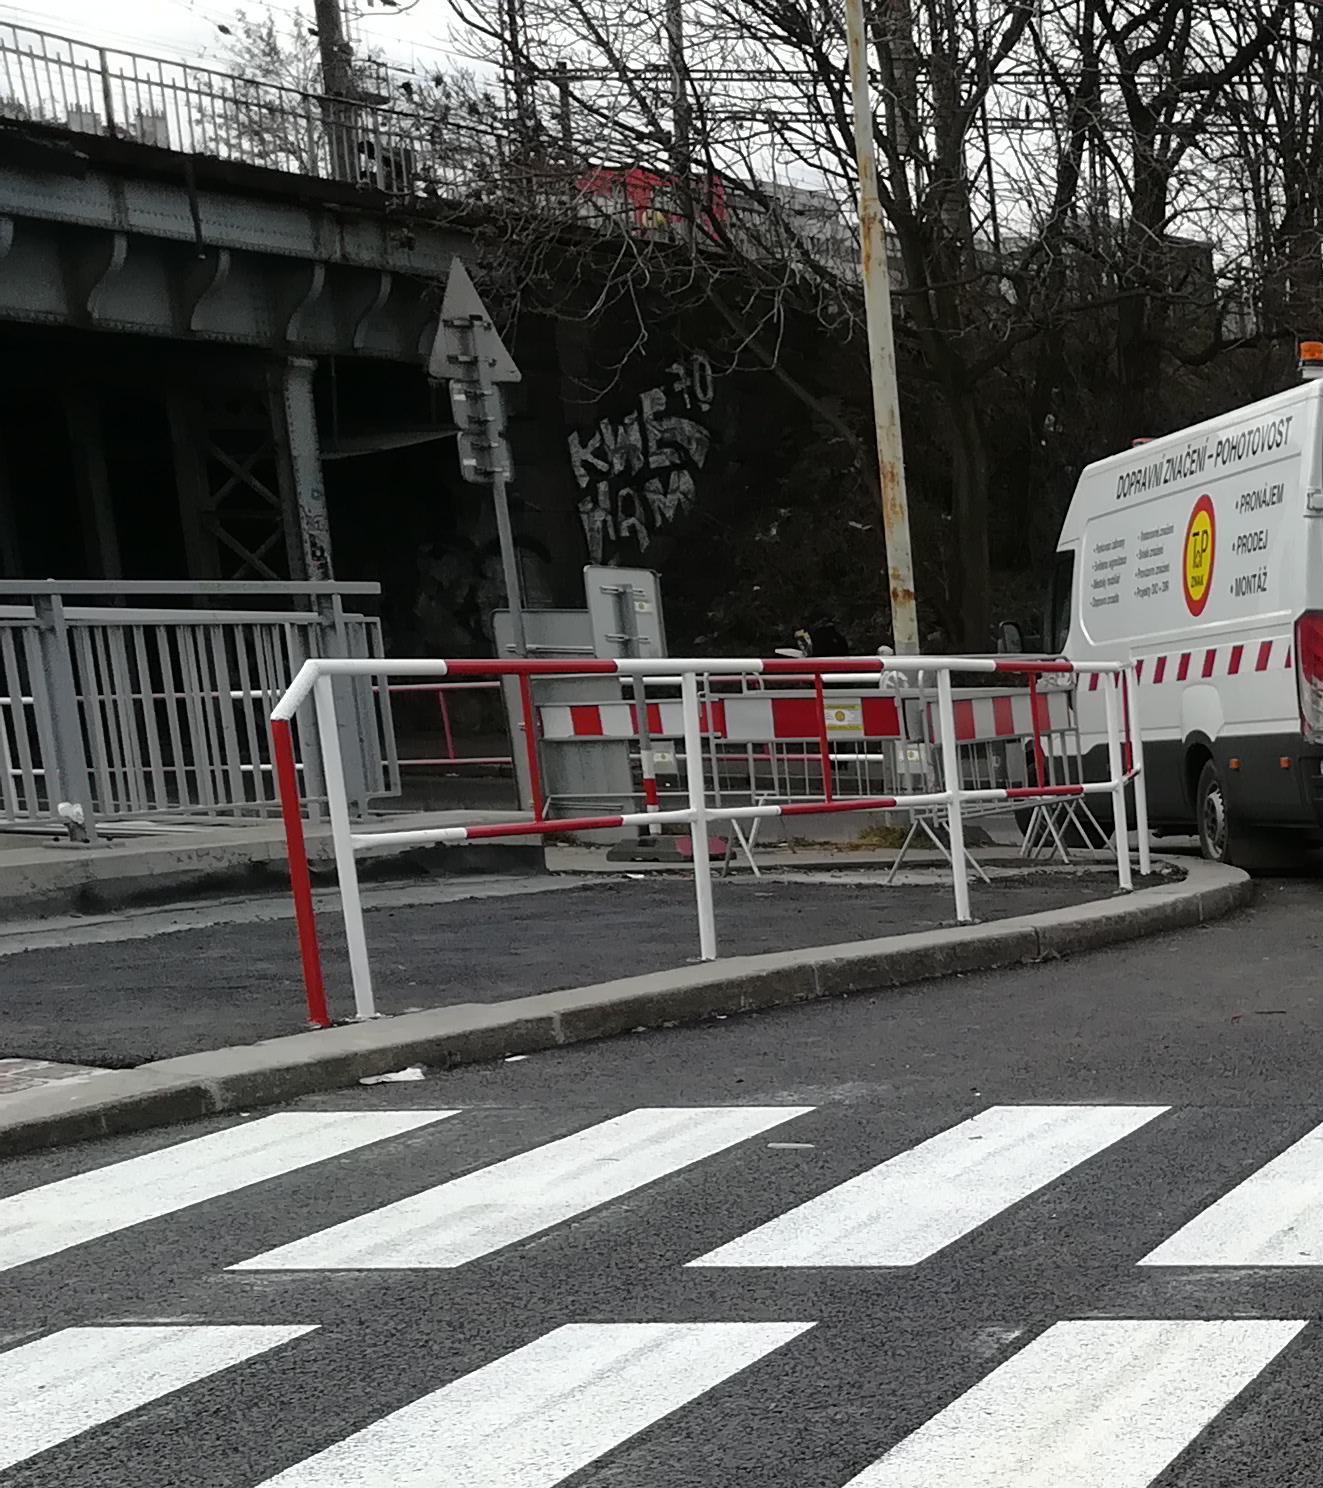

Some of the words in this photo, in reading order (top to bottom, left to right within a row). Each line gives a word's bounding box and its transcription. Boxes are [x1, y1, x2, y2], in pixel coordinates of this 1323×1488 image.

[1116, 454, 1165, 500] DOPRAVNÍ
[1163, 437, 1209, 484] ZNAČENÍ
[1214, 416, 1293, 468] POHOTOVOST
[1240, 482, 1284, 514] PRONÁJEM
[1236, 529, 1268, 555] PRODEJ
[1235, 566, 1268, 597] MONTÁŽ
